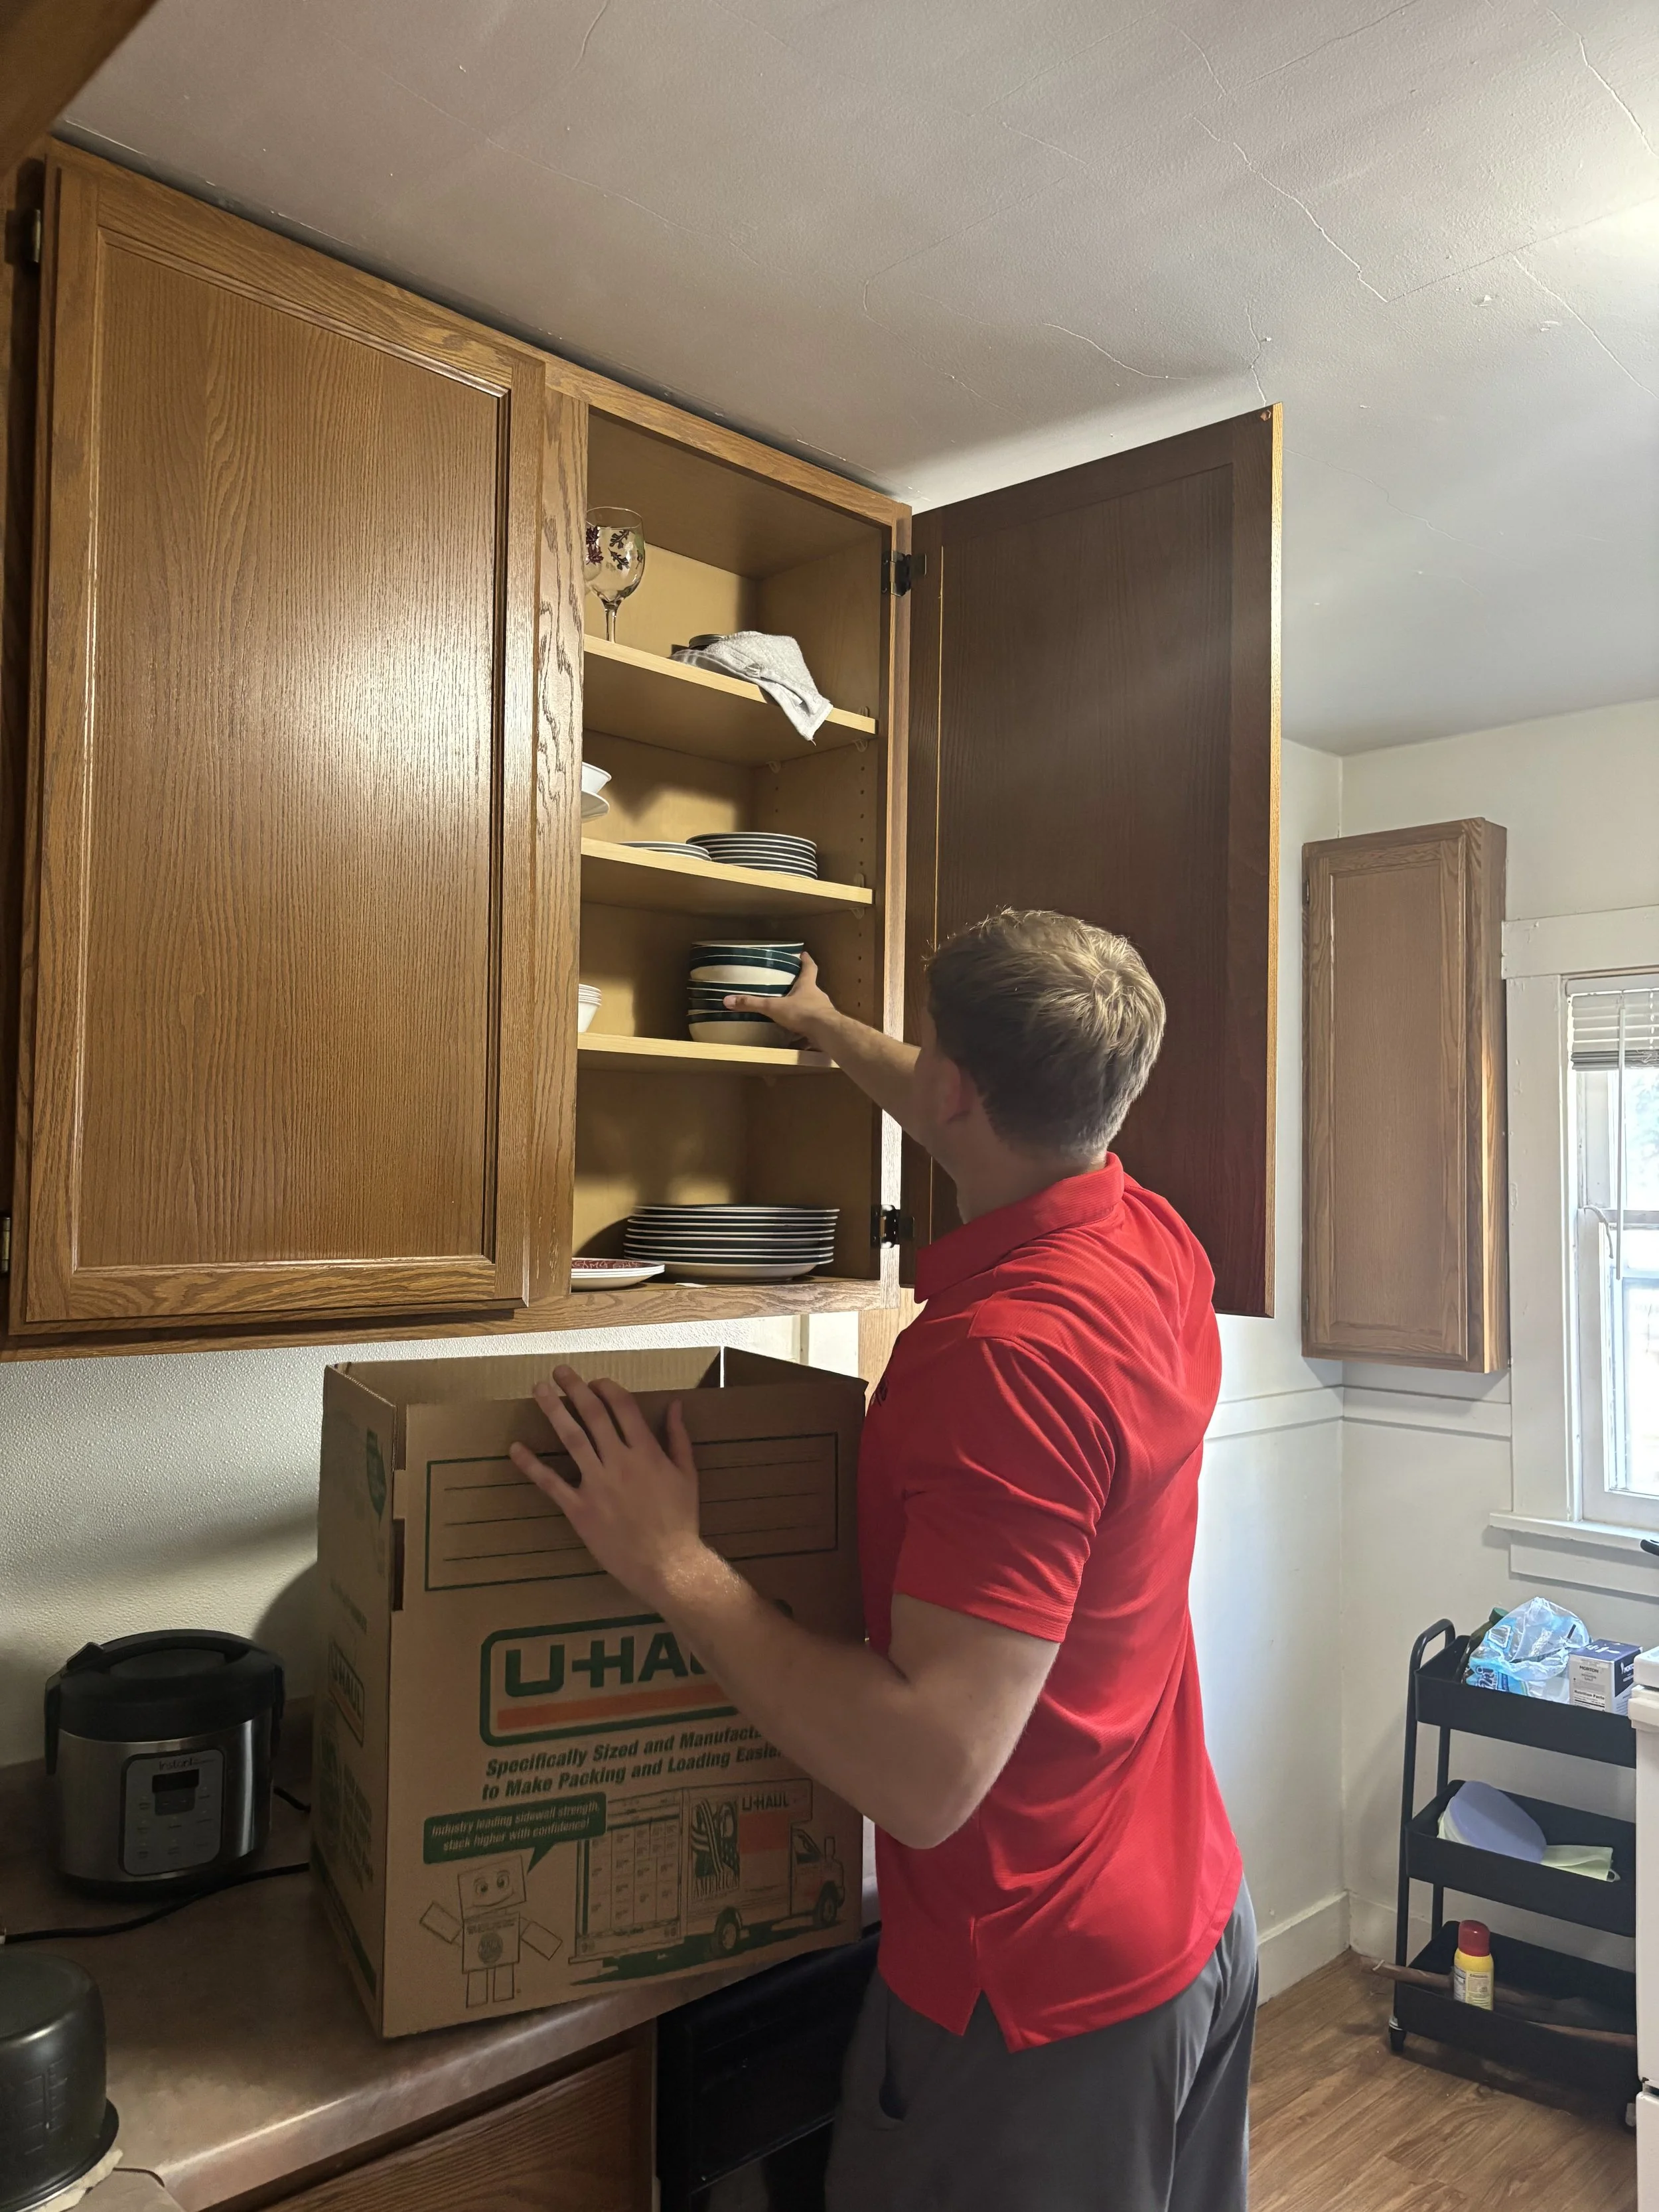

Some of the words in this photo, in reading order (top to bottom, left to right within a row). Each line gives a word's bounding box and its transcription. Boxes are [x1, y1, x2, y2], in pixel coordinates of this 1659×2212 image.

[1579, 1664, 1599, 1674] MORTON
[1574, 1689, 1593, 1698] Nutrition
[159, 1758, 192, 1771] Instant
[486, 1748, 587, 1779] Specifically
[593, 1739, 639, 1761] Sized
[644, 1735, 675, 1755] and
[482, 1783, 499, 1801] to
[505, 1776, 553, 1797] Make
[558, 1767, 626, 1791] Packing
[631, 1757, 662, 1778] and
[668, 1751, 731, 1773] Loading
[736, 1741, 782, 1763] Easie
[742, 1793, 788, 1811] U-HAUL
[431, 1821, 474, 1836] Industry
[476, 1815, 512, 1830] leading
[515, 1806, 555, 1824] sidewall
[443, 1837, 470, 1851] stack
[474, 1832, 504, 1847] higher
[509, 1826, 530, 1841] with
[533, 1817, 590, 1837] confidence!
